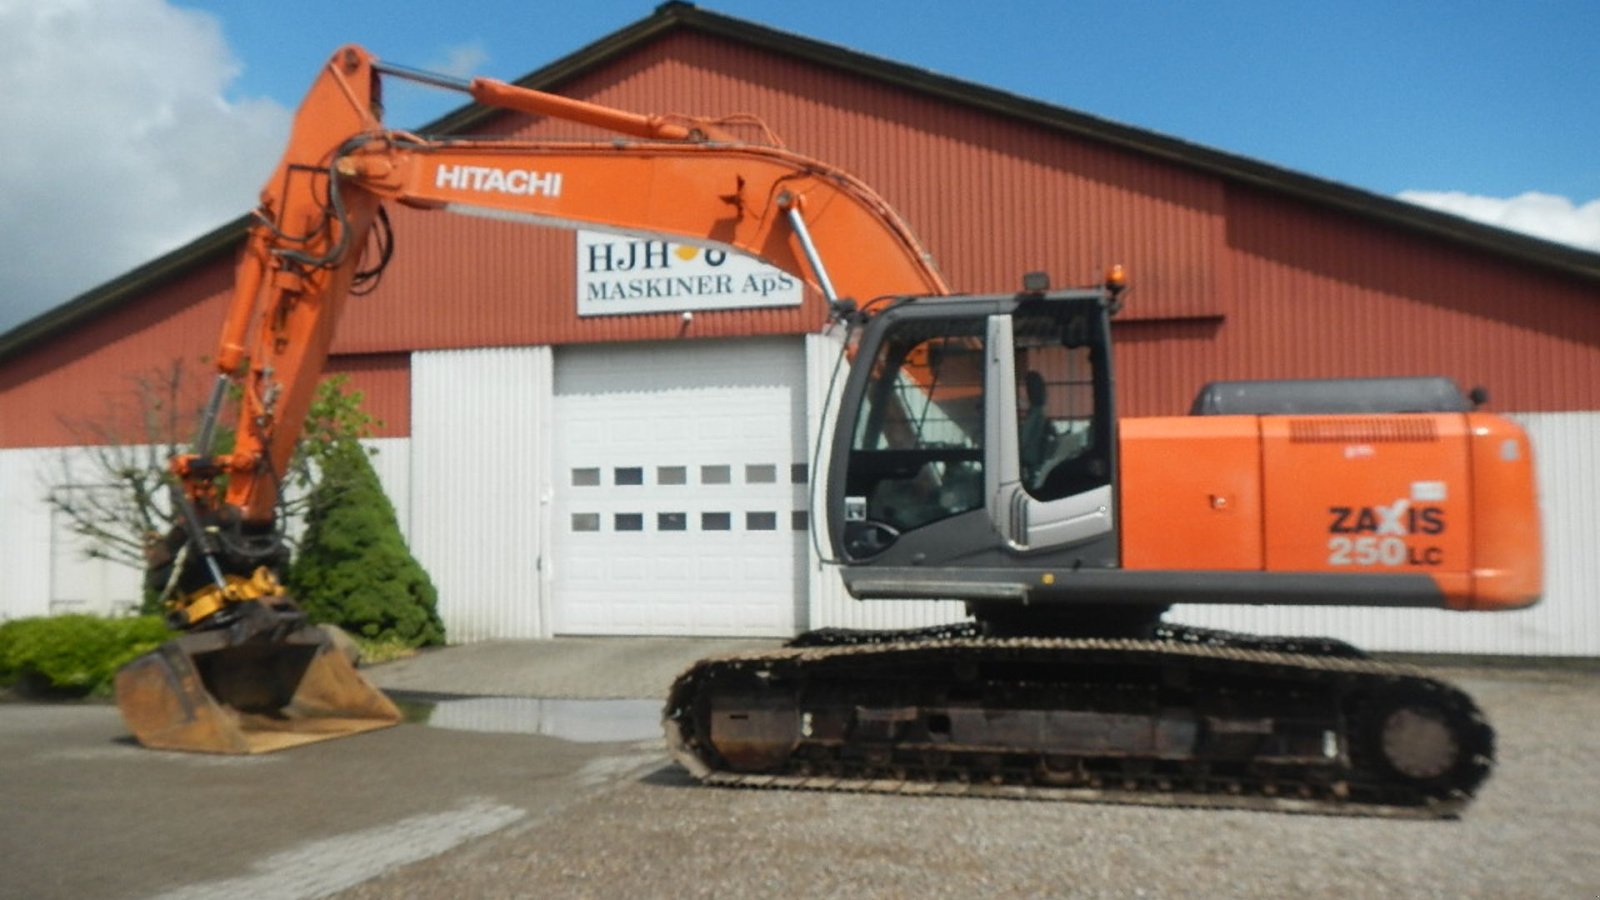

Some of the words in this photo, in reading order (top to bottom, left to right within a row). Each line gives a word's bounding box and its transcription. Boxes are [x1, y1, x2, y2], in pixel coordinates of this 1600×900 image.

[436, 164, 562, 197] HITACHI
[588, 240, 671, 272] HJH
[587, 275, 733, 301] MASKINER
[742, 272, 793, 296] ApS
[1328, 499, 1446, 535] ZAXIS
